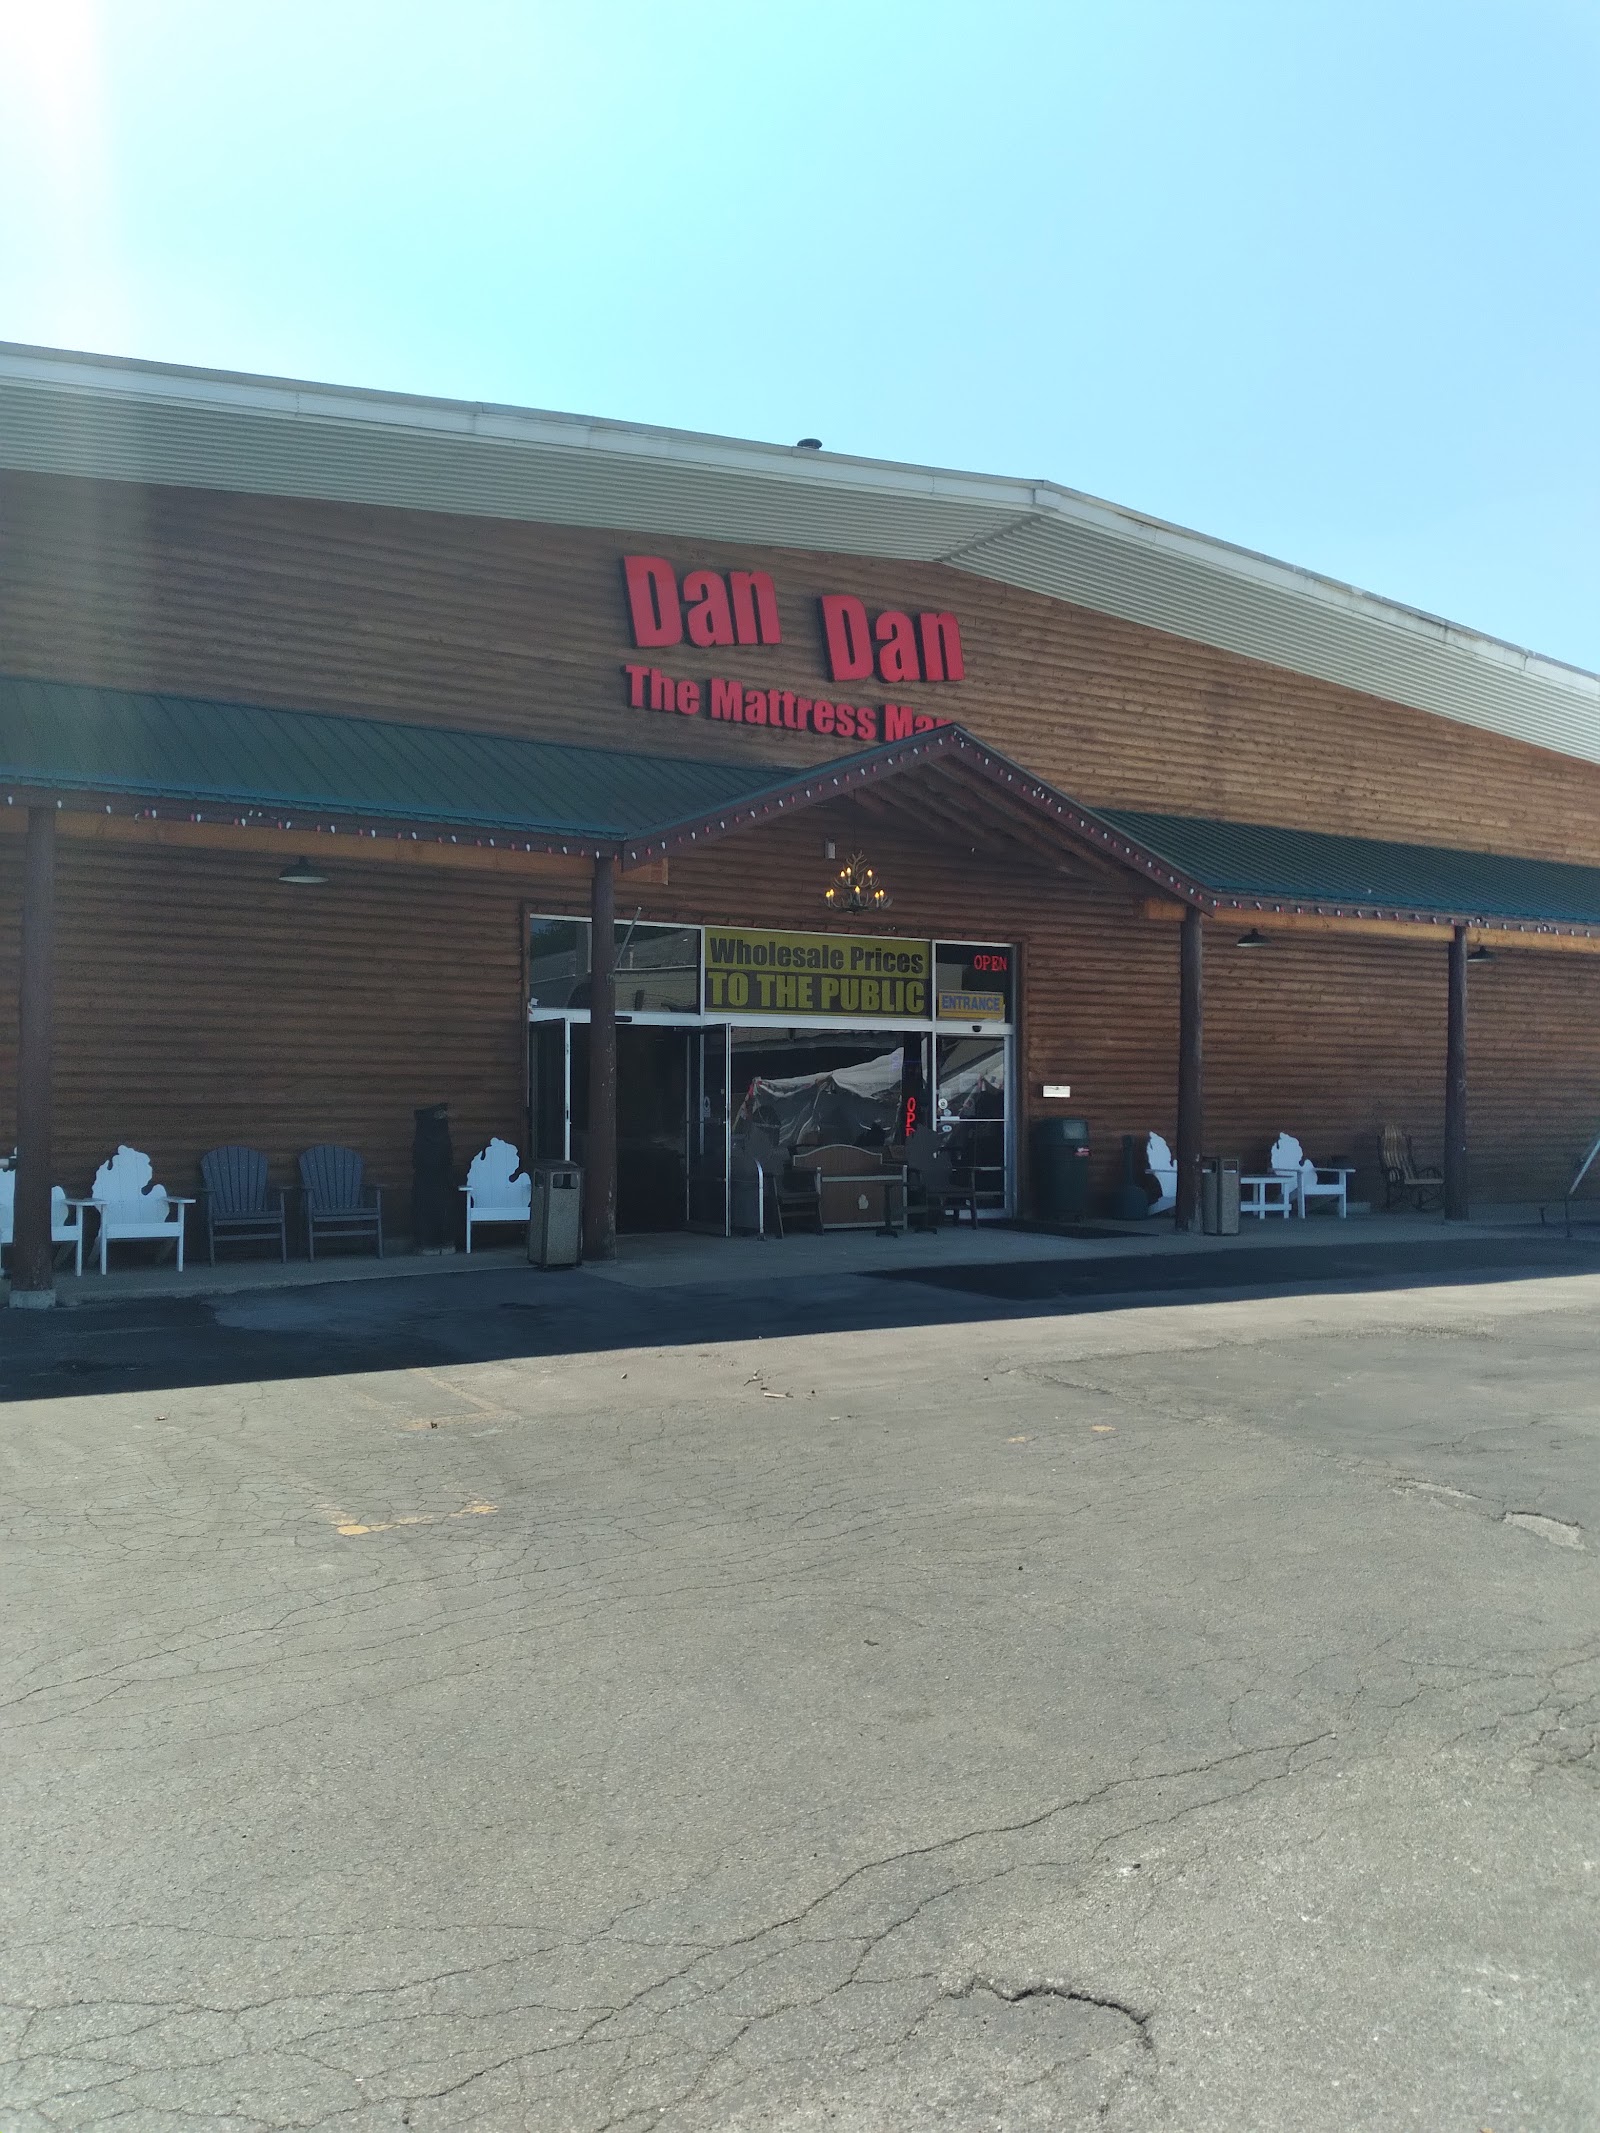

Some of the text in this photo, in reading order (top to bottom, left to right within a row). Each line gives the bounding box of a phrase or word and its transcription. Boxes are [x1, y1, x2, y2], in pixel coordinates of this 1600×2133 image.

[624, 556, 965, 682] Dan Dan
[625, 664, 700, 714] The
[711, 679, 876, 740] Mattress
[709, 937, 924, 974] Wholesale Prices
[974, 955, 1008, 971] OPEN
[708, 972, 925, 1013] TO THE PUBLIC
[942, 995, 1000, 1011] ENTRANCE
